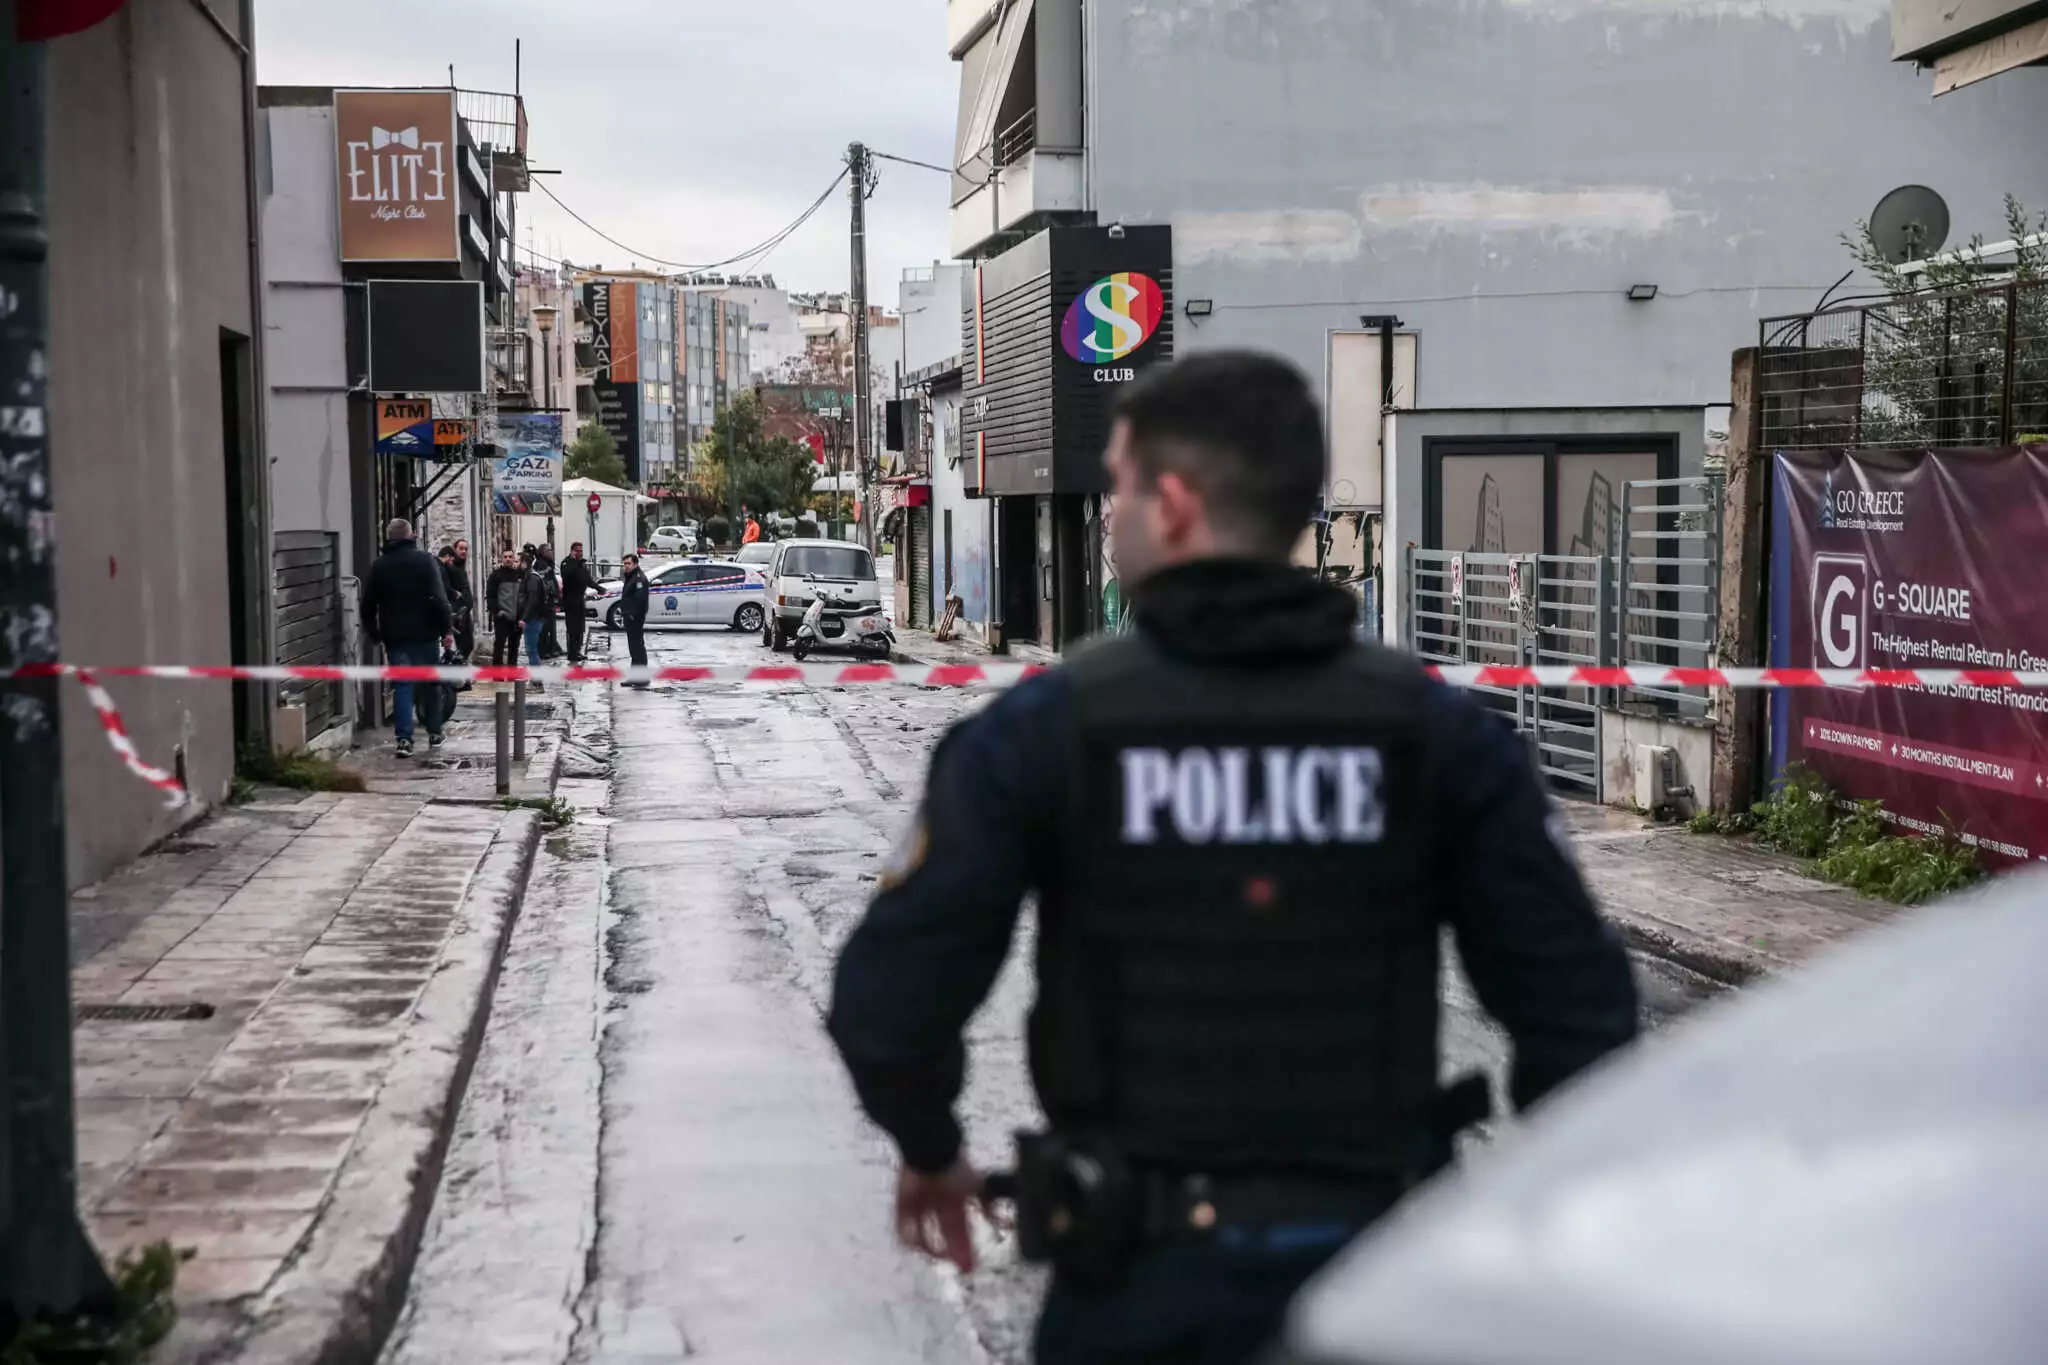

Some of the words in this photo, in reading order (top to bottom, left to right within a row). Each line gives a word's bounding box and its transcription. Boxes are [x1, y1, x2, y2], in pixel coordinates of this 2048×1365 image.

[347, 141, 446, 201] ELITE
[370, 205, 402, 222] Night
[404, 205, 426, 219] Club
[1093, 368, 1135, 382] CLUB
[383, 403, 425, 418] ATM
[1836, 490, 1856, 513] GO
[1858, 491, 1904, 515] GREECE
[1836, 518, 1849, 528] Real
[1849, 518, 1866, 530] Estate
[1873, 580, 1885, 610] G
[1898, 582, 1972, 621] SQUARE
[1820, 574, 1858, 669] G
[1872, 631, 1889, 652] The
[1889, 632, 1931, 662] Highest
[1931, 639, 1966, 663] Rental
[1967, 643, 2004, 669] Return
[2006, 648, 2017, 669] In
[2019, 649, 2048, 673] Gree
[1950, 682, 2002, 705] Smartest
[1831, 730, 1852, 745] DOWN
[1852, 735, 1882, 752] PAYMENT
[1901, 746, 1911, 760] 30
[1911, 748, 1941, 766] MONTHS
[1942, 753, 1993, 777] INSTALLMENT
[1993, 765, 2014, 781] PLAN
[1120, 746, 1386, 846] POLICE
